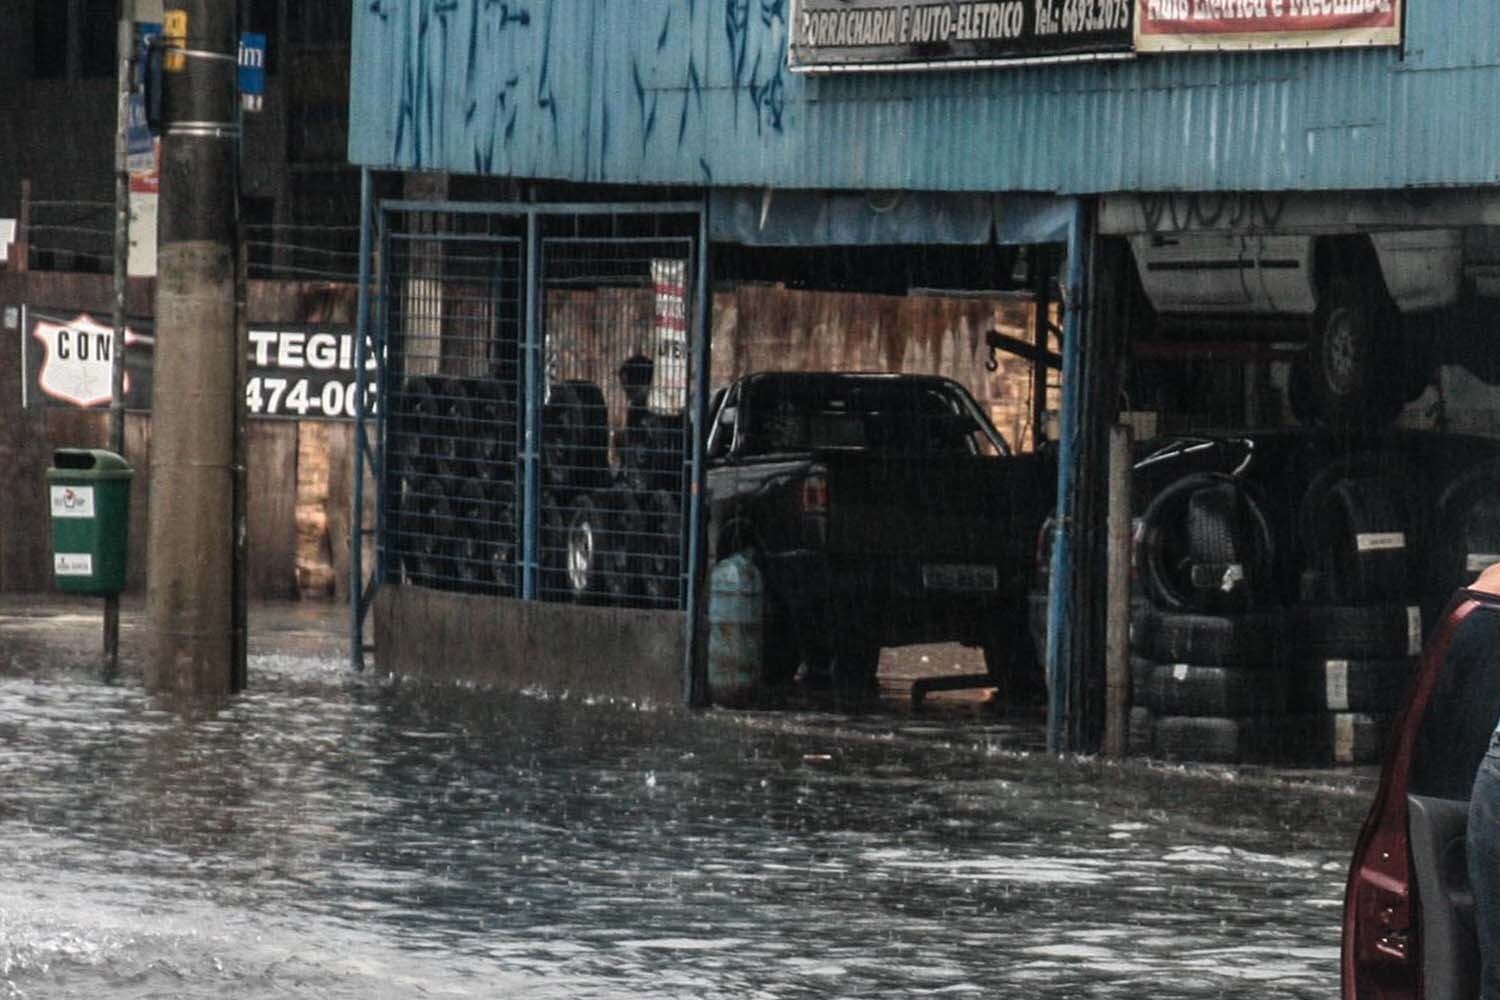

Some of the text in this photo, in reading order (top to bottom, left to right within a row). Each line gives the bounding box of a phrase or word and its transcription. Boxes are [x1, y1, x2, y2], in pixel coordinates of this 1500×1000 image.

[801, 10, 896, 45] BORRACHARIA
[901, 8, 910, 42] E
[911, 2, 1023, 41] AUTO-ELETRICO
